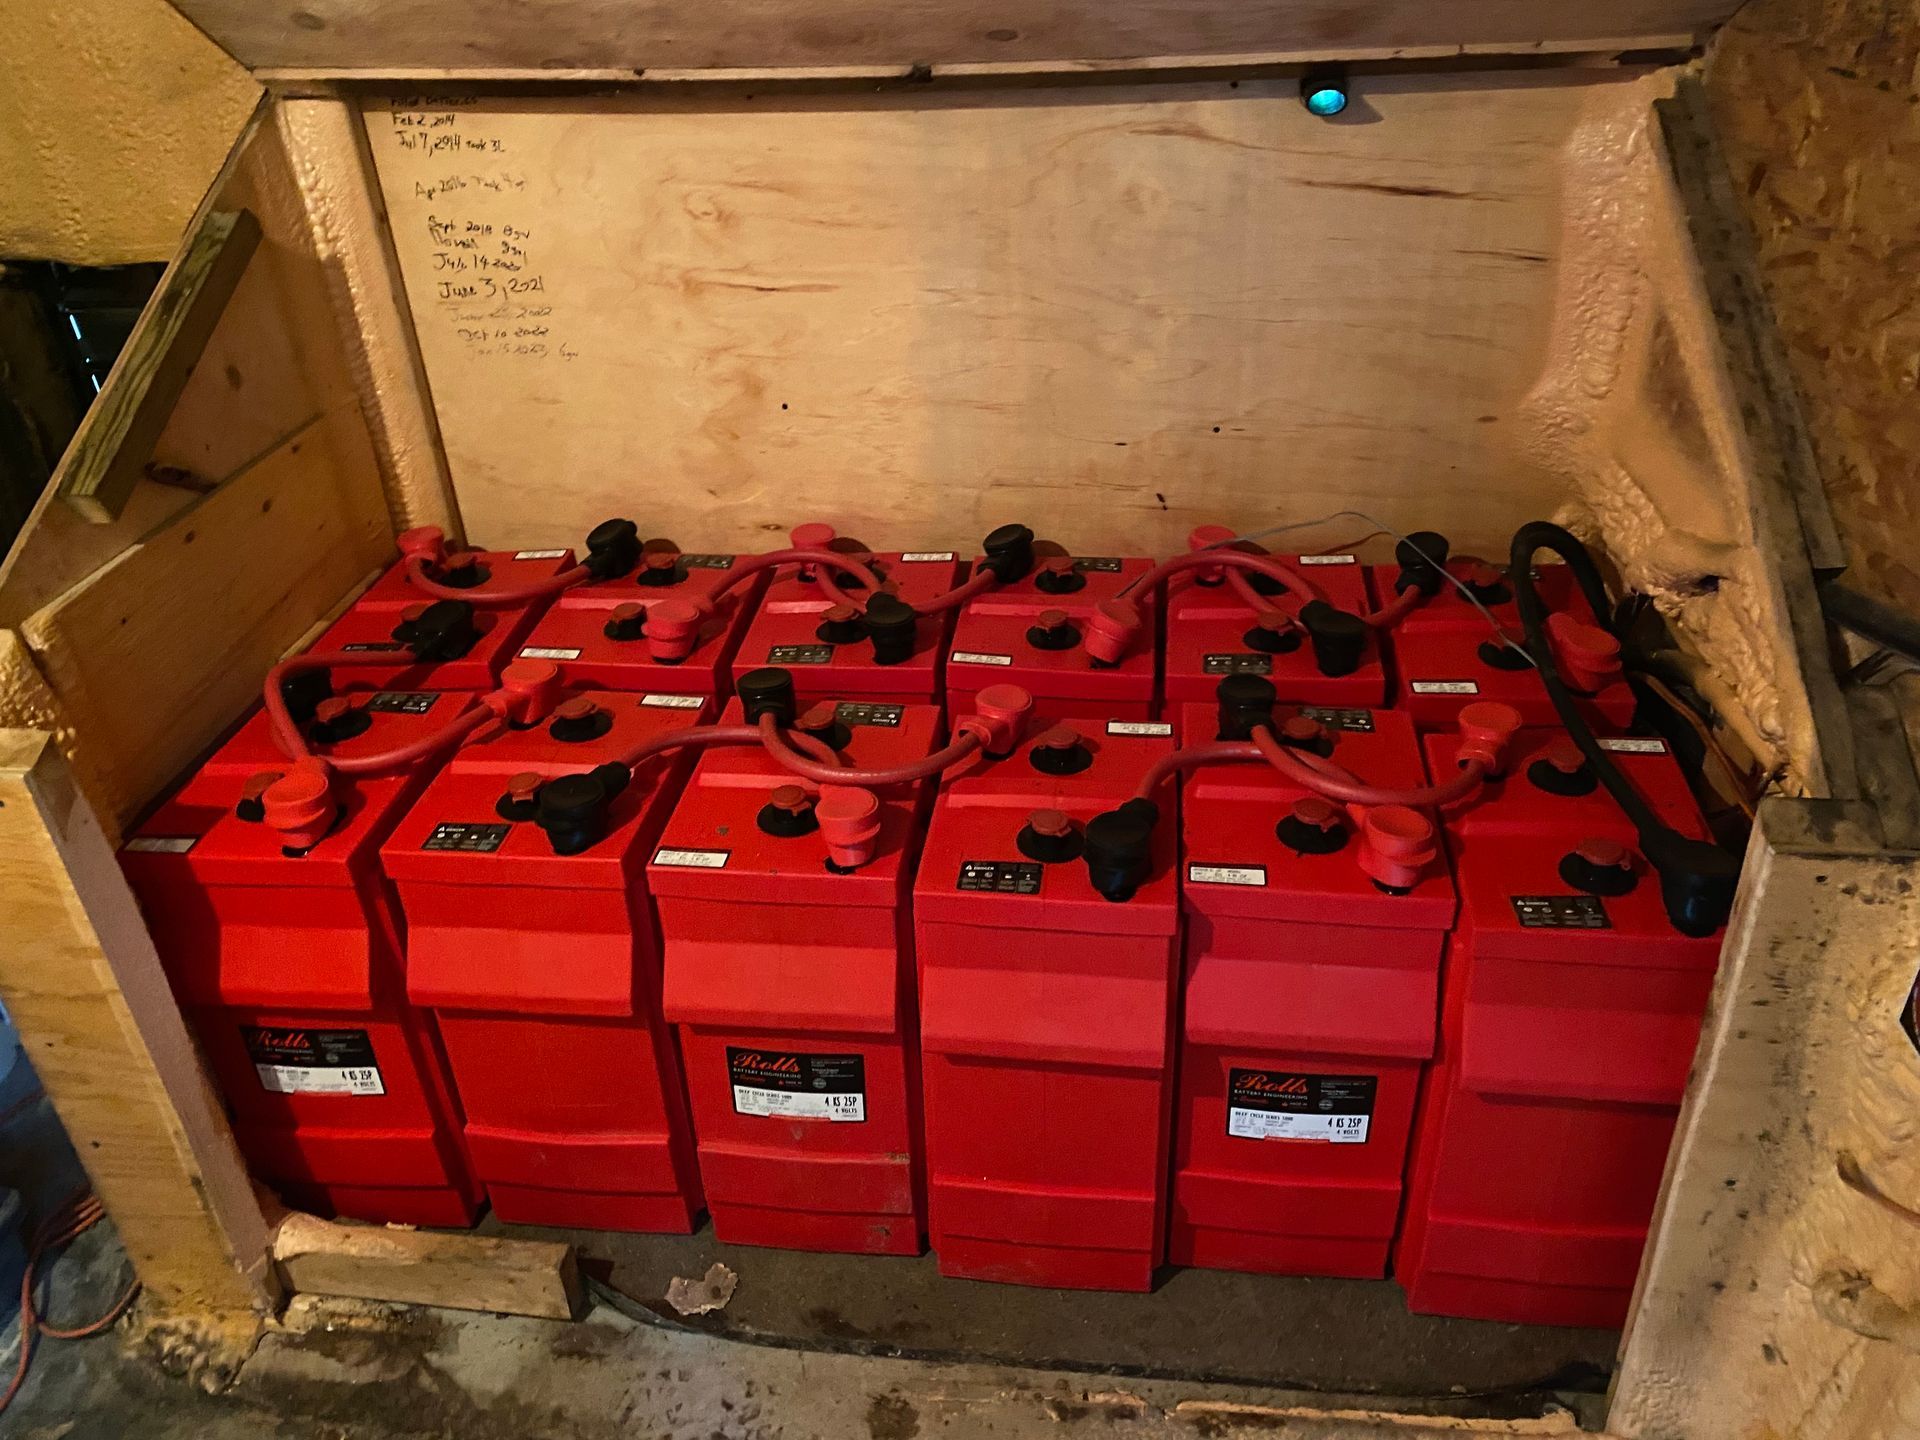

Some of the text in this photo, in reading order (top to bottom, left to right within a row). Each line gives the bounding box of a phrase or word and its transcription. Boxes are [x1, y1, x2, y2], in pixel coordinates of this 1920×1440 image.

[733, 1052, 802, 1074] Rolls
[1234, 1073, 1309, 1095] Rolls
[832, 1096, 841, 1107] KS
[843, 1096, 858, 1107] 25P
[1327, 1117, 1333, 1129] 4
[1336, 1117, 1345, 1129] KS
[1347, 1117, 1363, 1129] 25P
